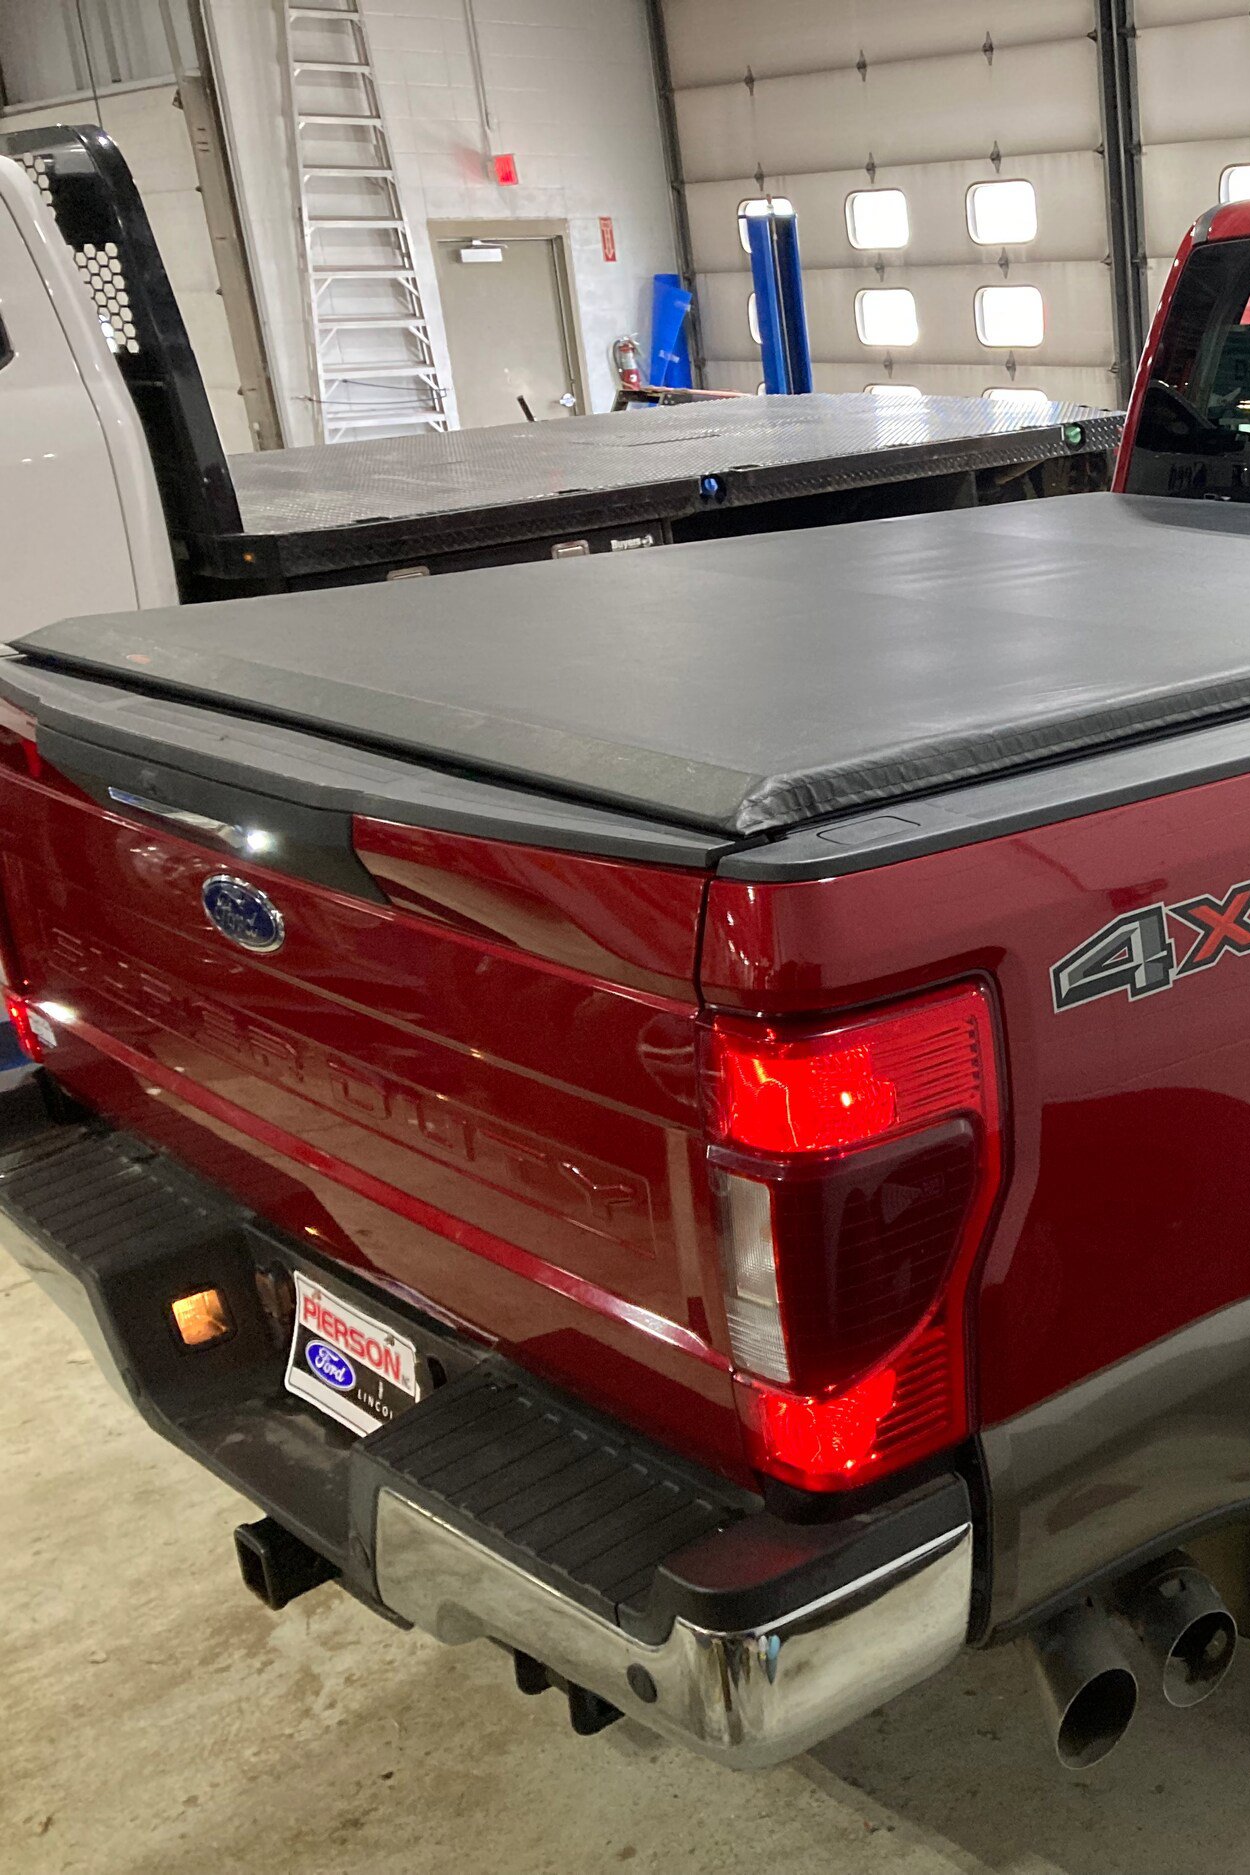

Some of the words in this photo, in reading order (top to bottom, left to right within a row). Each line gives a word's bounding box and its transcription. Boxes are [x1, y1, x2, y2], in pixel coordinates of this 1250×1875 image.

[326, 1060, 635, 1221] DUTY
[303, 1296, 402, 1381] PIERSON
[314, 1347, 346, 1383] Ford
